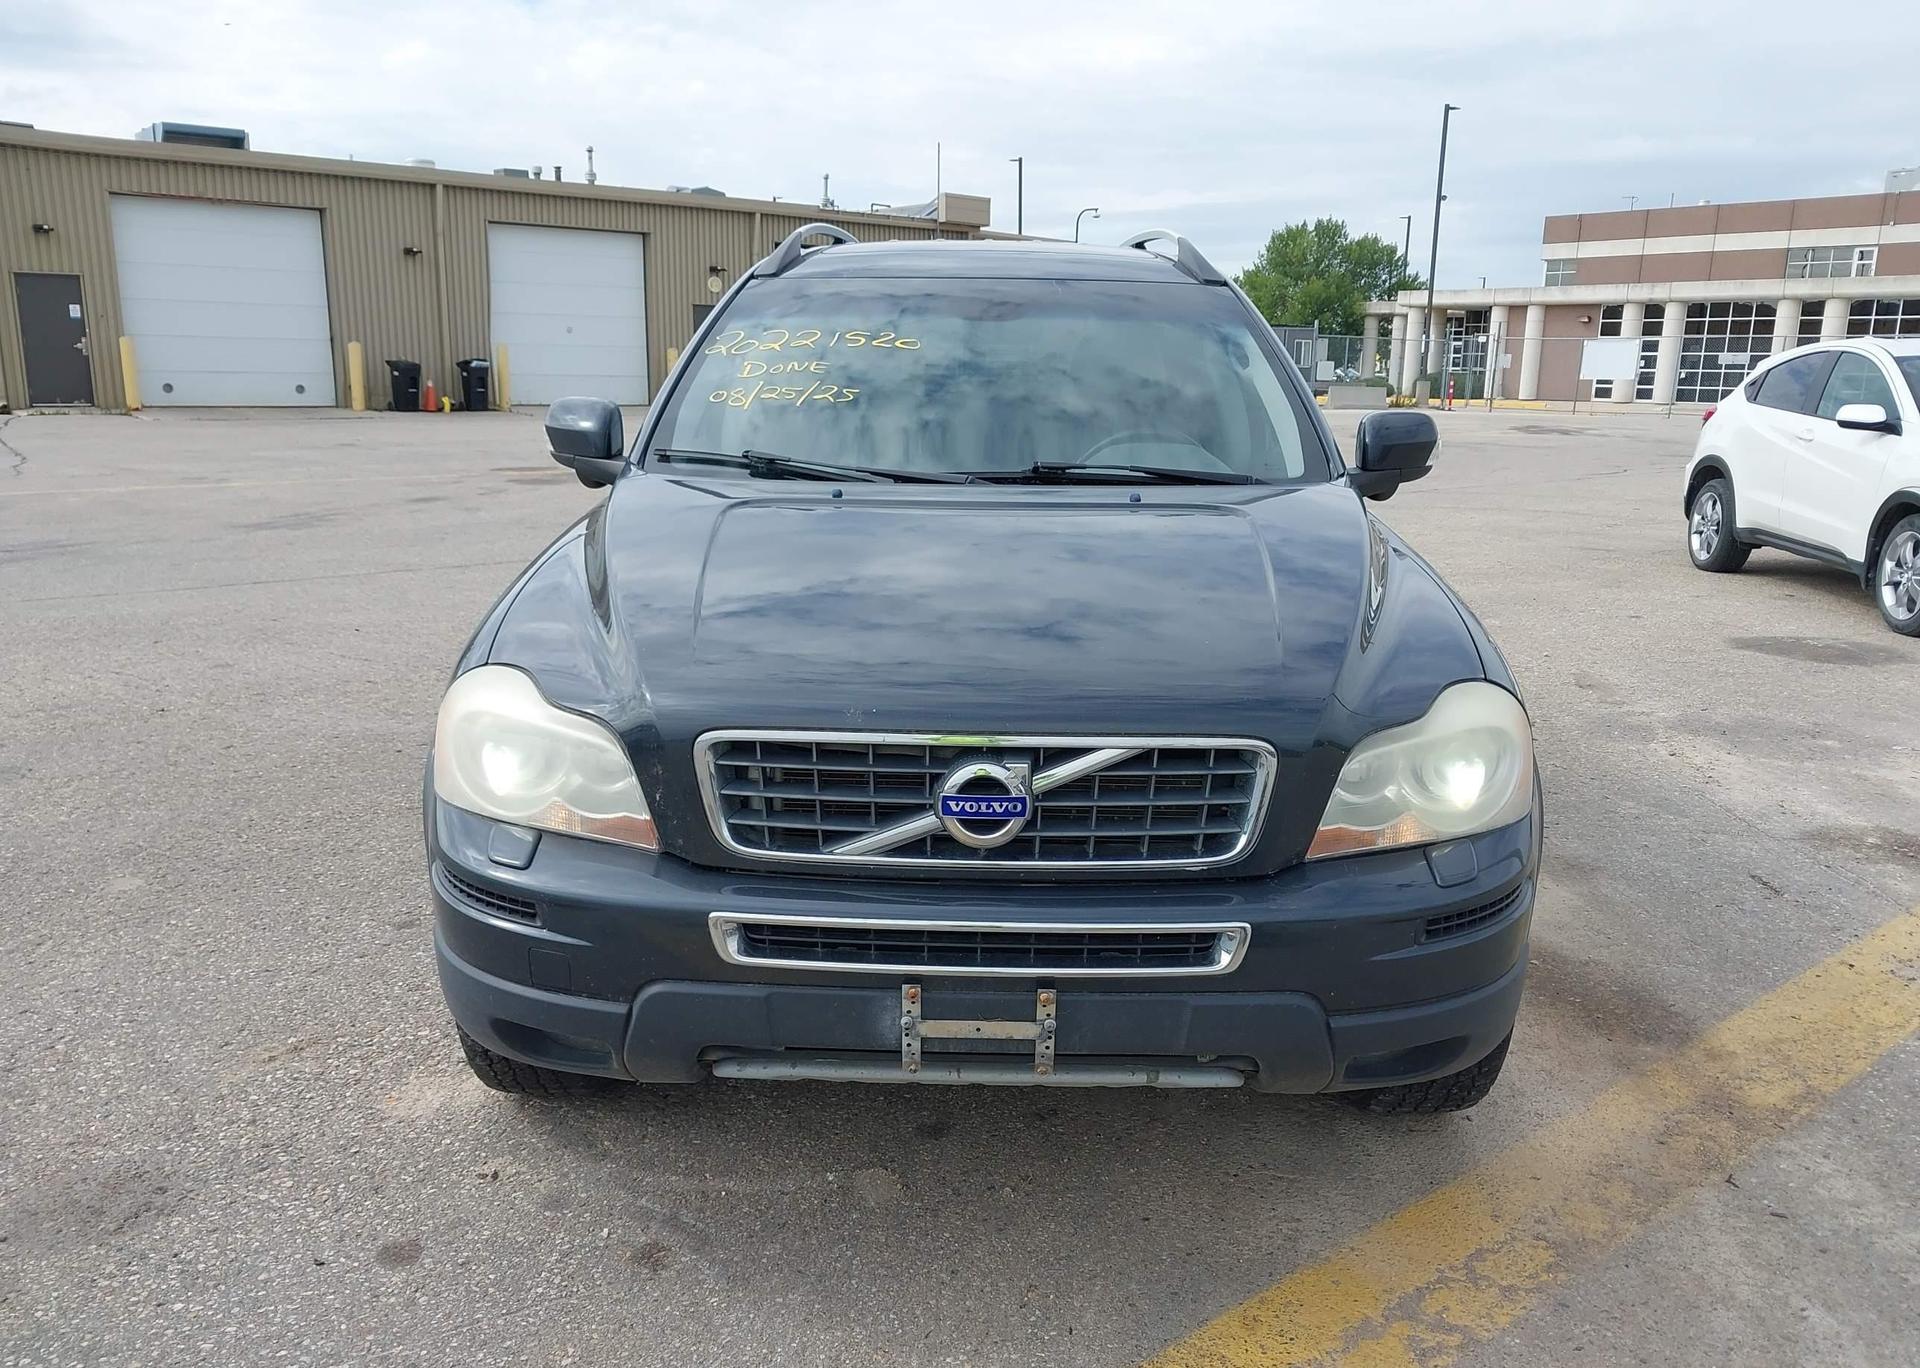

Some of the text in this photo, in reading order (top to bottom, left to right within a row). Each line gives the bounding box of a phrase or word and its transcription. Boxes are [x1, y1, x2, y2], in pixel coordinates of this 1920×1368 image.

[704, 329, 921, 356] 20221520
[737, 360, 832, 378] DONE
[708, 380, 860, 410] 08/25/25
[946, 800, 1023, 813] VOLVO
